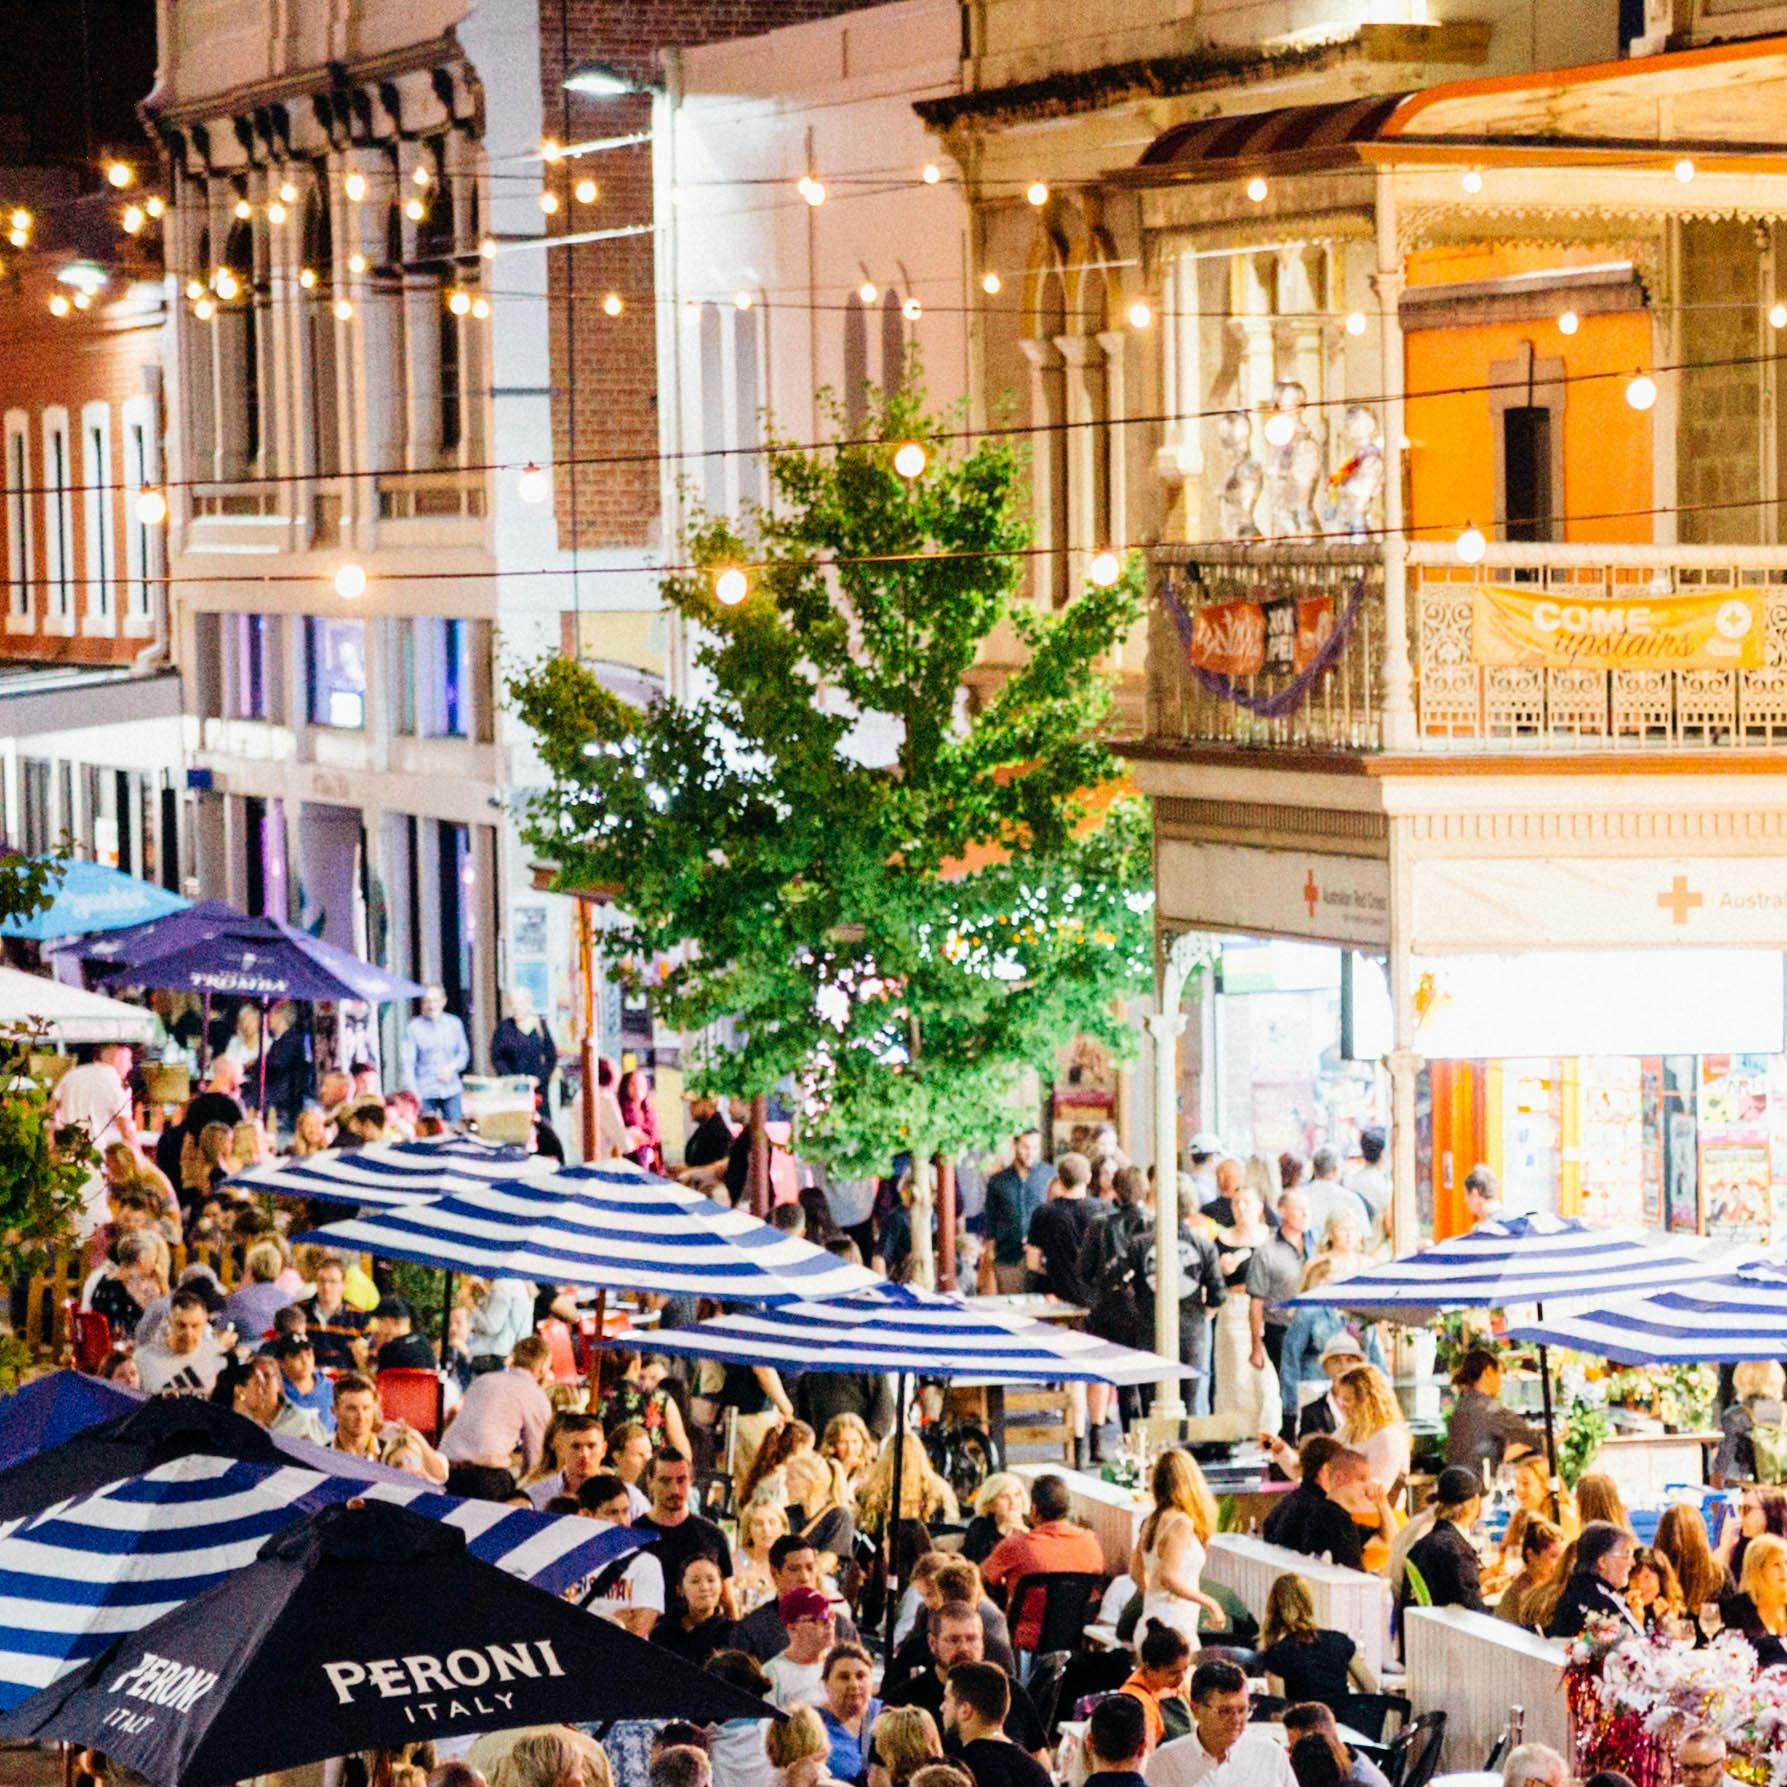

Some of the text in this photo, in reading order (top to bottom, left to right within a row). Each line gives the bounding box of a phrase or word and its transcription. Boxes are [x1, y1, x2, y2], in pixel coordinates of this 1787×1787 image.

[1532, 602, 1652, 633] COME
[1554, 627, 1697, 663] upstairs
[107, 1652, 221, 1714] PERONI
[322, 1639, 567, 1706] PERONI
[102, 1706, 156, 1735] ITALY
[404, 1692, 515, 1725] ITALY
